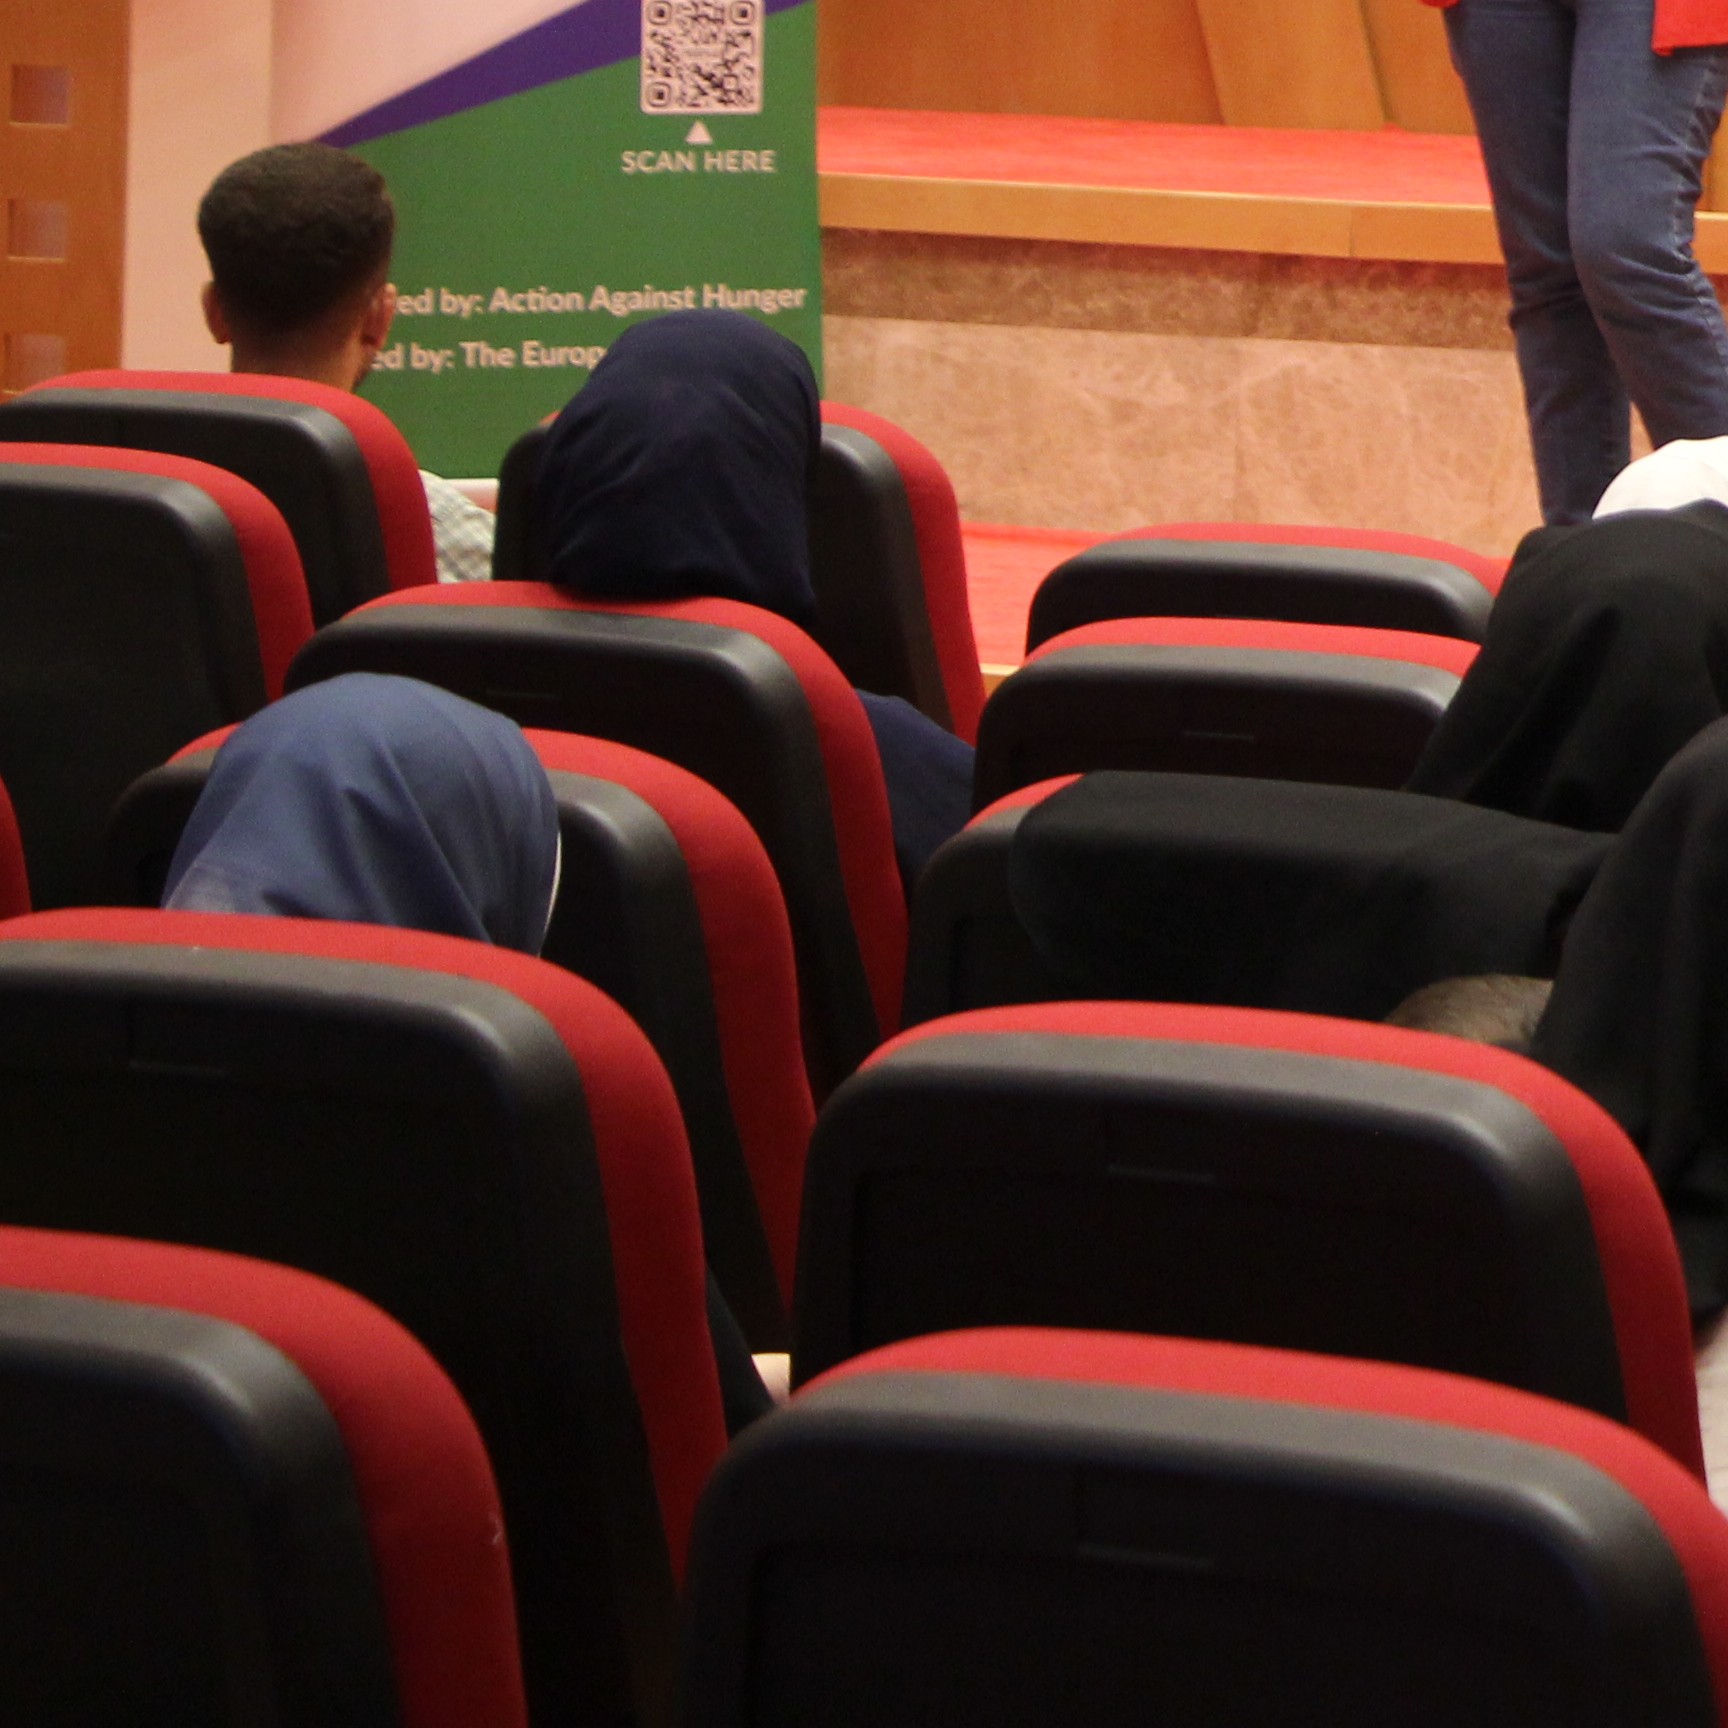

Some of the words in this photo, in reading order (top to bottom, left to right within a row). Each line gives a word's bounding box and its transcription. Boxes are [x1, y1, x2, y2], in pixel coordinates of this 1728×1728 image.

[621, 149, 696, 173] SCAN
[703, 149, 777, 173] HERE
[396, 287, 435, 315] ed
[439, 287, 484, 319] by:
[488, 285, 586, 314] Action
[588, 284, 696, 317] Against
[702, 283, 808, 315] Hunger
[409, 341, 455, 373] by:
[458, 340, 516, 368] The
[521, 339, 608, 369] Europ
